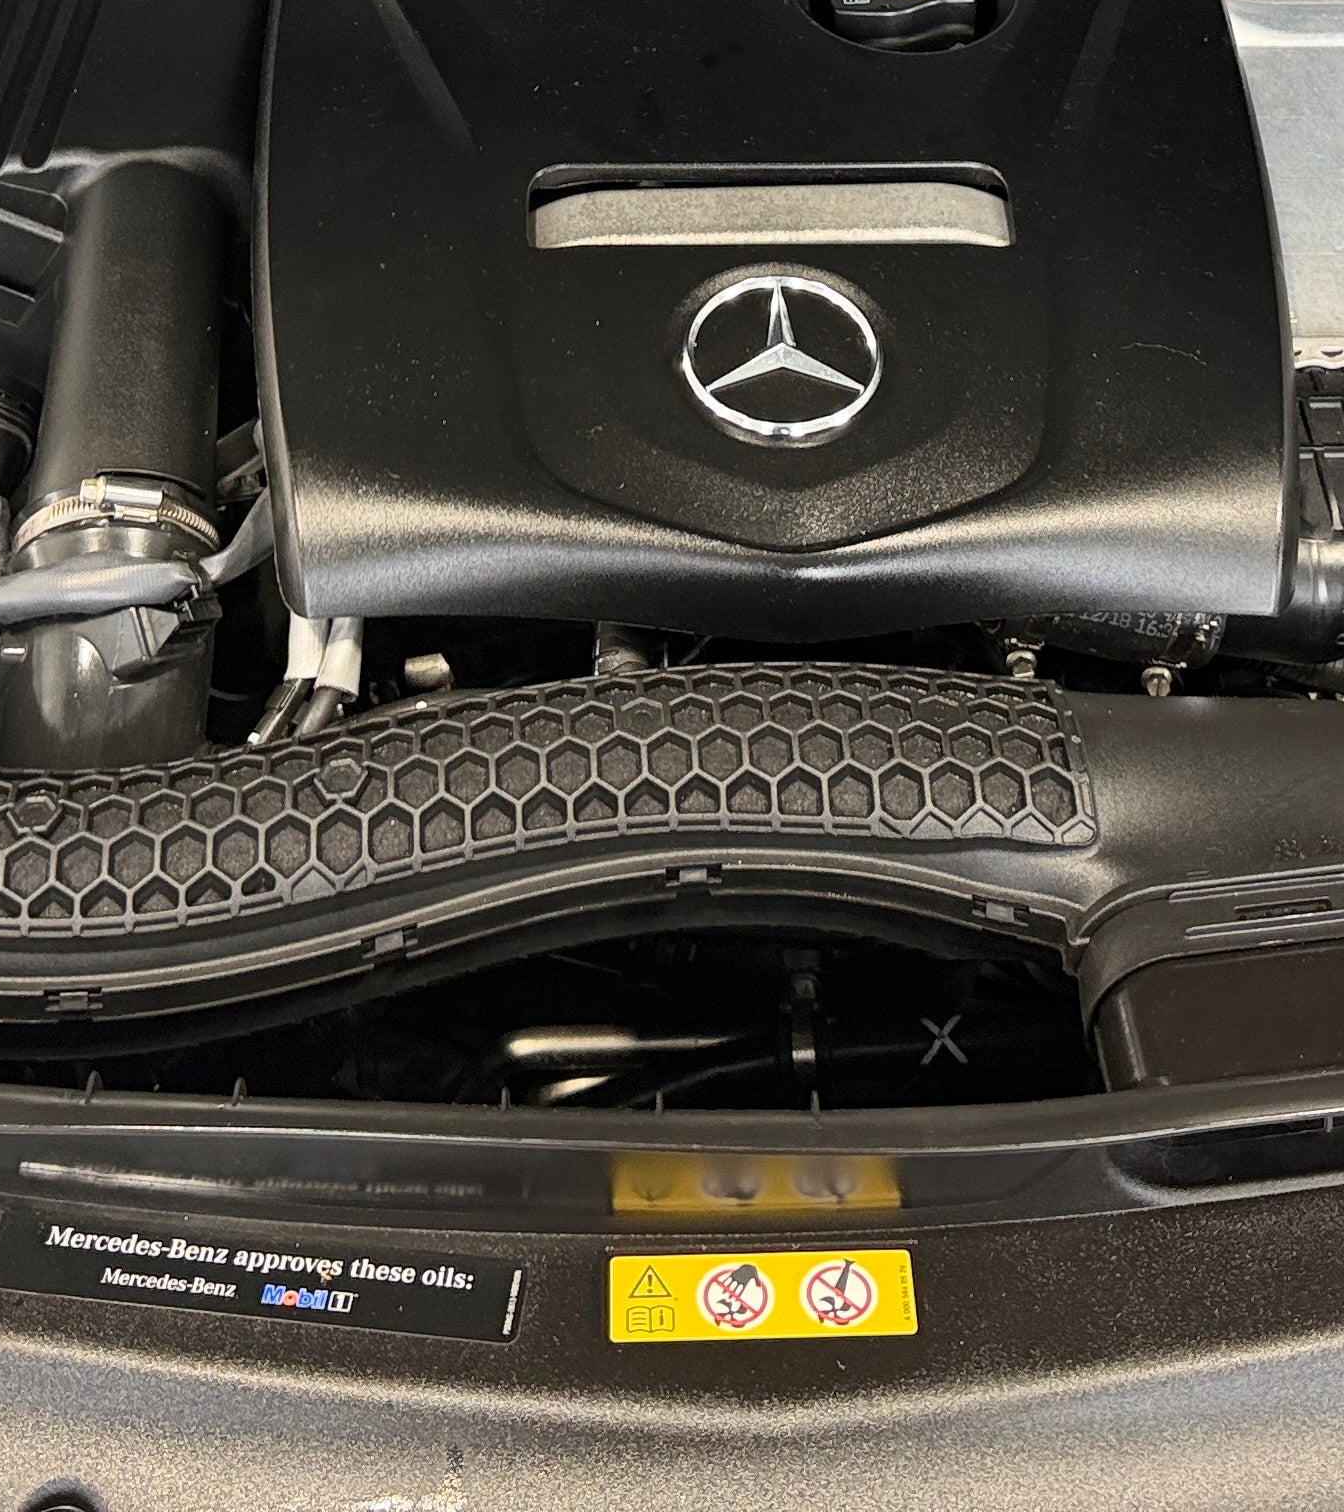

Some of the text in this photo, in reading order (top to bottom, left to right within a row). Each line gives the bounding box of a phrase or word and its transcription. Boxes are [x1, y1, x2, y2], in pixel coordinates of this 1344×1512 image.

[44, 1225, 474, 1290] Mercedes-Benz approves these oils:
[100, 1267, 237, 1298] Mercedes-Benz
[261, 1284, 328, 1310] Mobil
